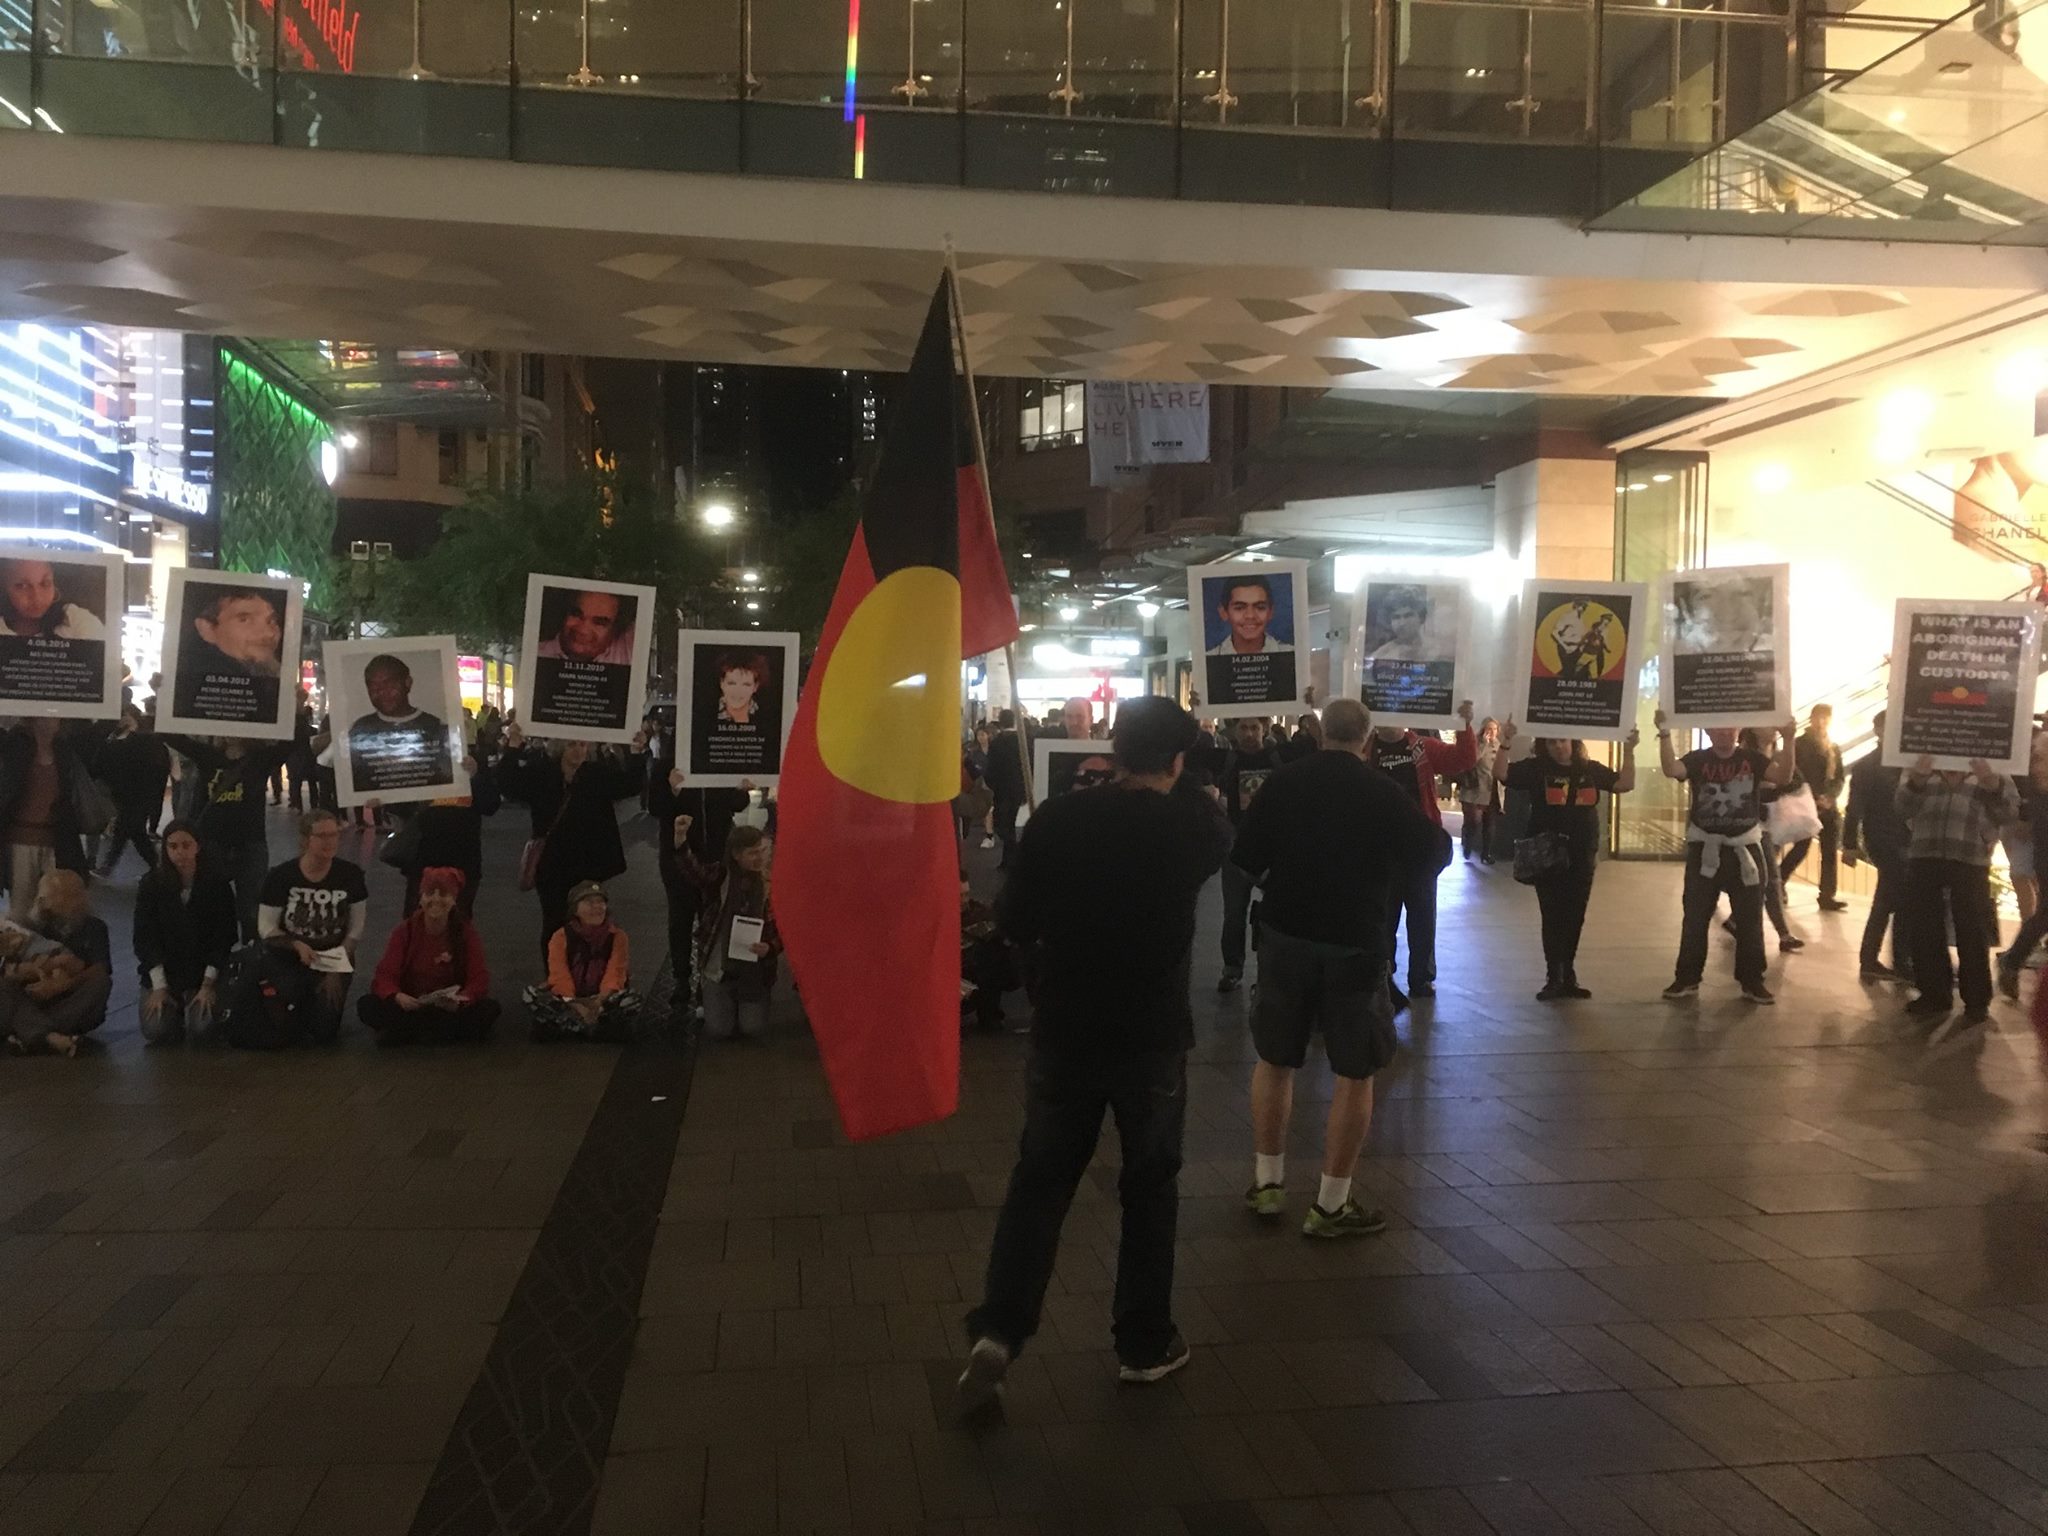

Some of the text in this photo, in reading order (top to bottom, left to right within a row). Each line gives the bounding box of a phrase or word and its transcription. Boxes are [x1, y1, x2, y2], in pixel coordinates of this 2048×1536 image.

[1129, 391, 1203, 409] HERE
[1093, 401, 1126, 416] LIV
[1094, 421, 1125, 437] HE
[1920, 616, 2020, 630] WHAT IS AN
[1912, 633, 2018, 647] ABORIGINAL
[1926, 650, 2006, 664] DEATH IN
[564, 662, 605, 672] 11.11.2010
[1919, 667, 2010, 680] CUSTODY?
[288, 886, 348, 905] STOP
